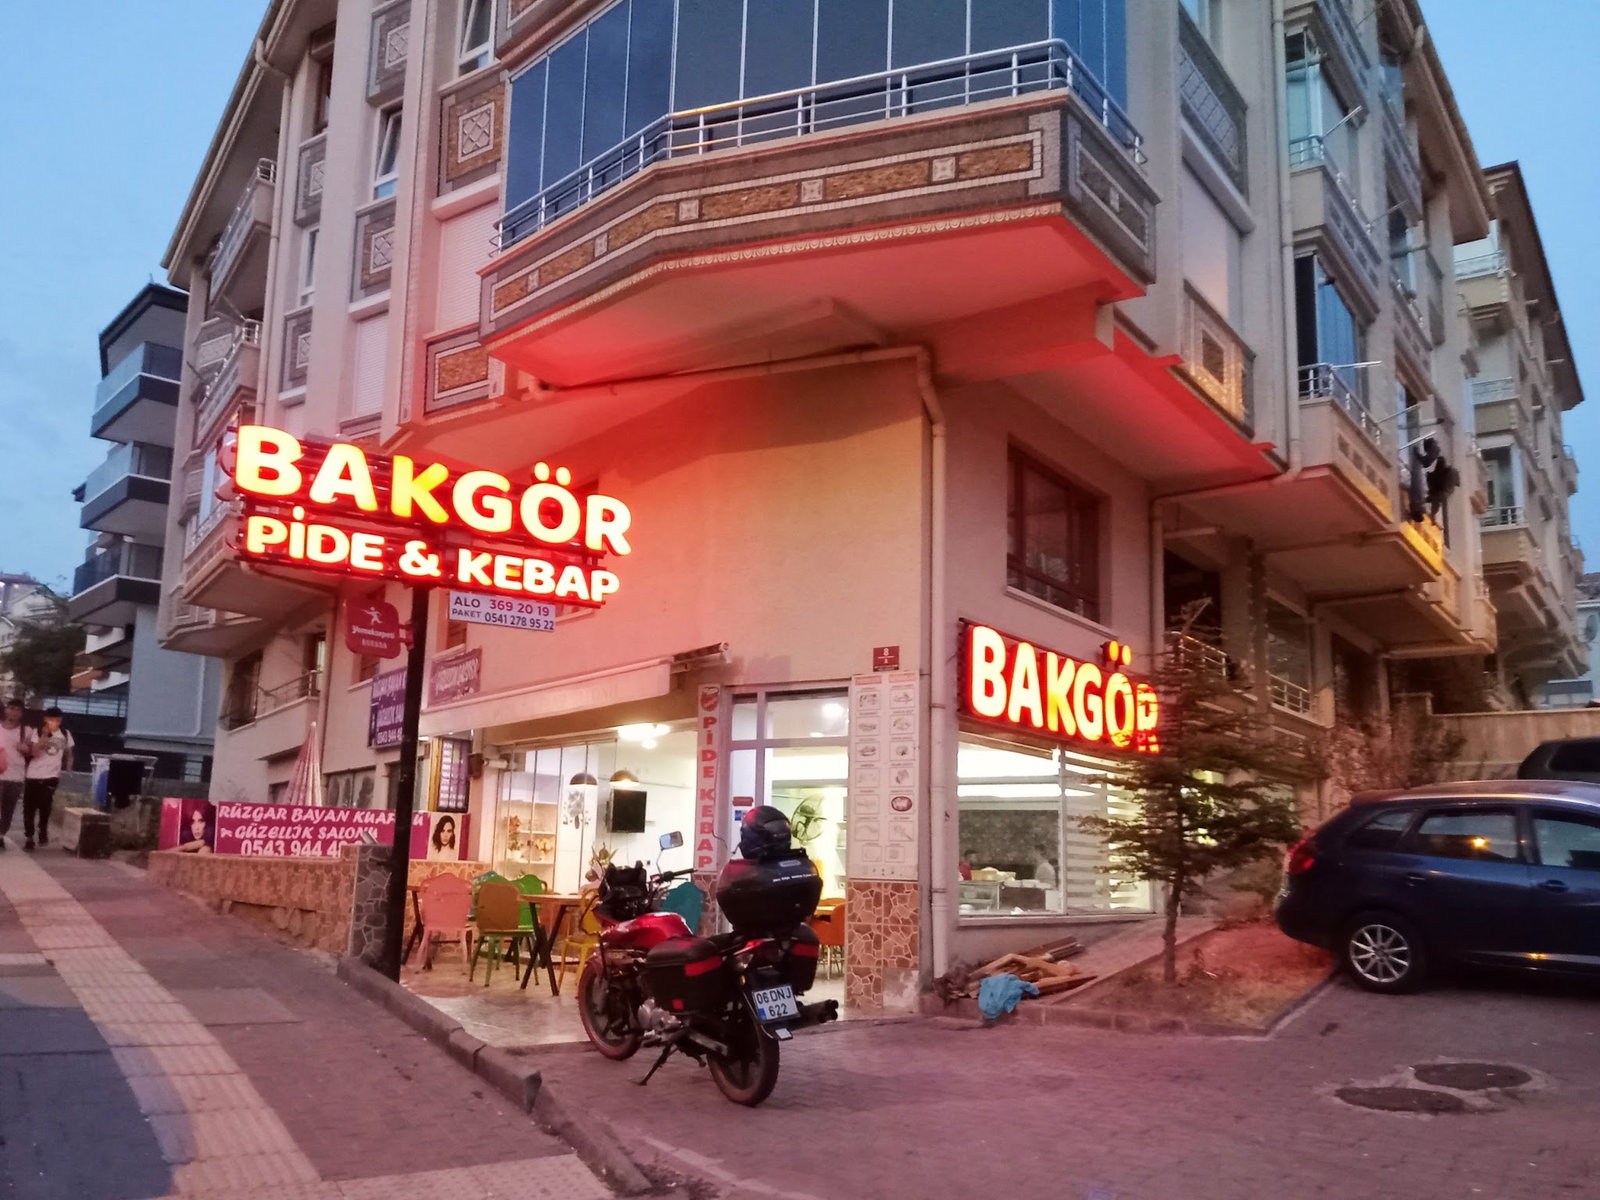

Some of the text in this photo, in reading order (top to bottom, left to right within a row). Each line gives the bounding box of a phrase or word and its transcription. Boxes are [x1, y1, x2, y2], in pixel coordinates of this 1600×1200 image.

[236, 425, 632, 556] BAKGÖR
[247, 506, 620, 602] PİDE & KEBAP
[454, 596, 550, 617] ALO 369 20 19
[452, 608, 554, 631] PAKET 0541 278 95 22
[697, 715, 717, 869] PİDE KEBAP
[219, 803, 288, 822] RÜZGAR
[291, 807, 350, 824] BAYAN
[241, 839, 285, 857] 0543
[290, 840, 322, 857] 944
[756, 987, 792, 1005] 06 DNJ
[768, 1003, 788, 1017] 622
